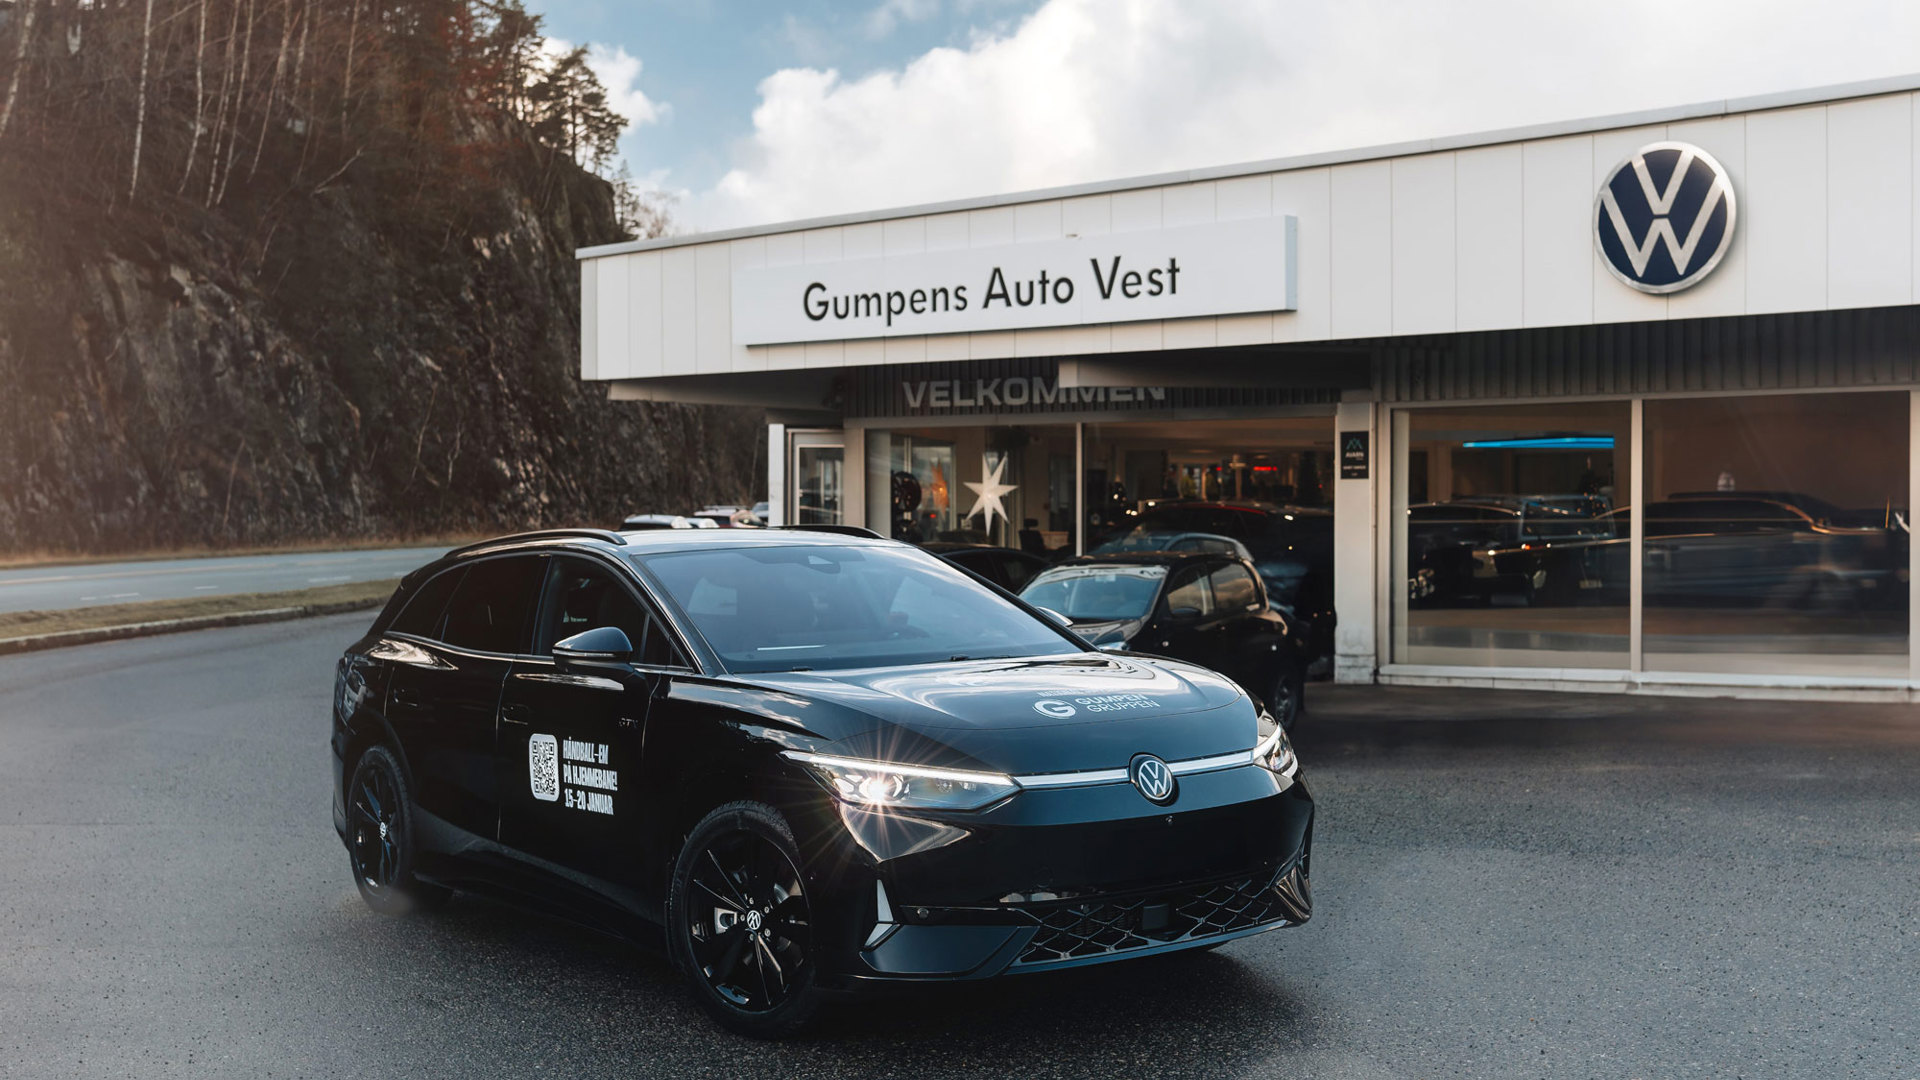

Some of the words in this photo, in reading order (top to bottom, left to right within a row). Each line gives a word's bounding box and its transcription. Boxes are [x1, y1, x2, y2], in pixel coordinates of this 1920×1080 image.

[803, 282, 968, 326] Gumpens
[982, 267, 1075, 309] Auto
[1090, 255, 1181, 300] Vest
[1075, 694, 1149, 705] GUMPEN
[1086, 700, 1161, 712] GRUPPEN
[562, 736, 609, 765] HÅNDBALL-EM
[562, 761, 572, 784] PÅ
[572, 765, 618, 791] HJEMMEBANE!
[564, 788, 586, 811] 15-20
[587, 791, 614, 815] JANUAR
